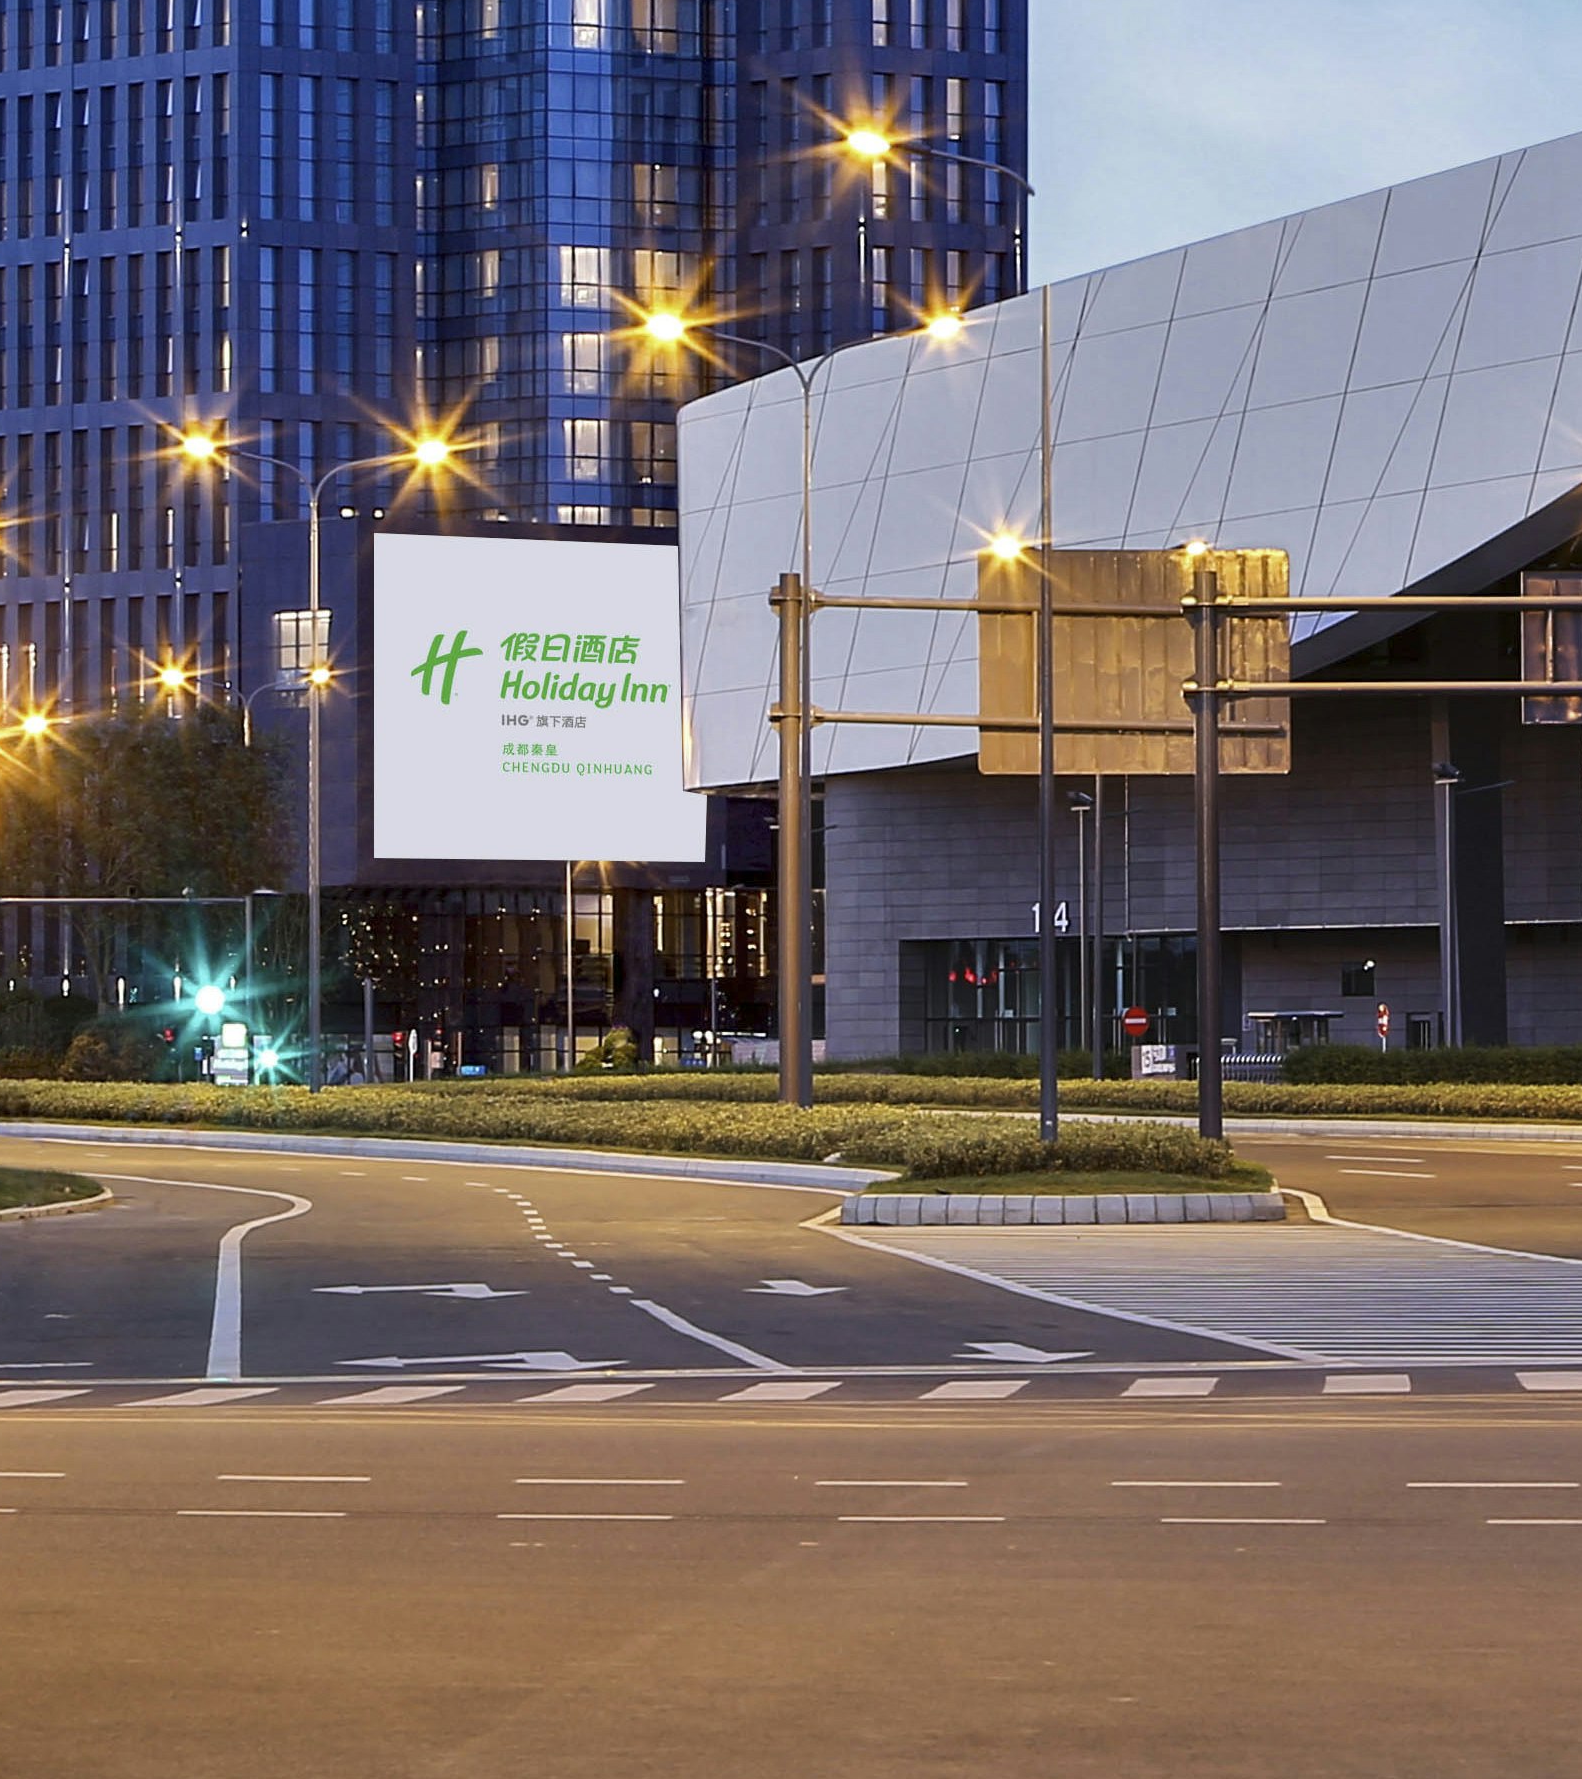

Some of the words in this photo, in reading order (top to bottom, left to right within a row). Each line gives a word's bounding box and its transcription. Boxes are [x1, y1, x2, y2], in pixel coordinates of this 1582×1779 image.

[500, 632, 641, 664] 假日酒店
[500, 670, 616, 709] Holiday
[620, 673, 668, 703] Inn
[536, 716, 587, 729] 旗下酒店
[502, 743, 558, 756] 成都秦皇
[502, 762, 570, 773] CHENGDU
[576, 763, 653, 776] QINHUANG
